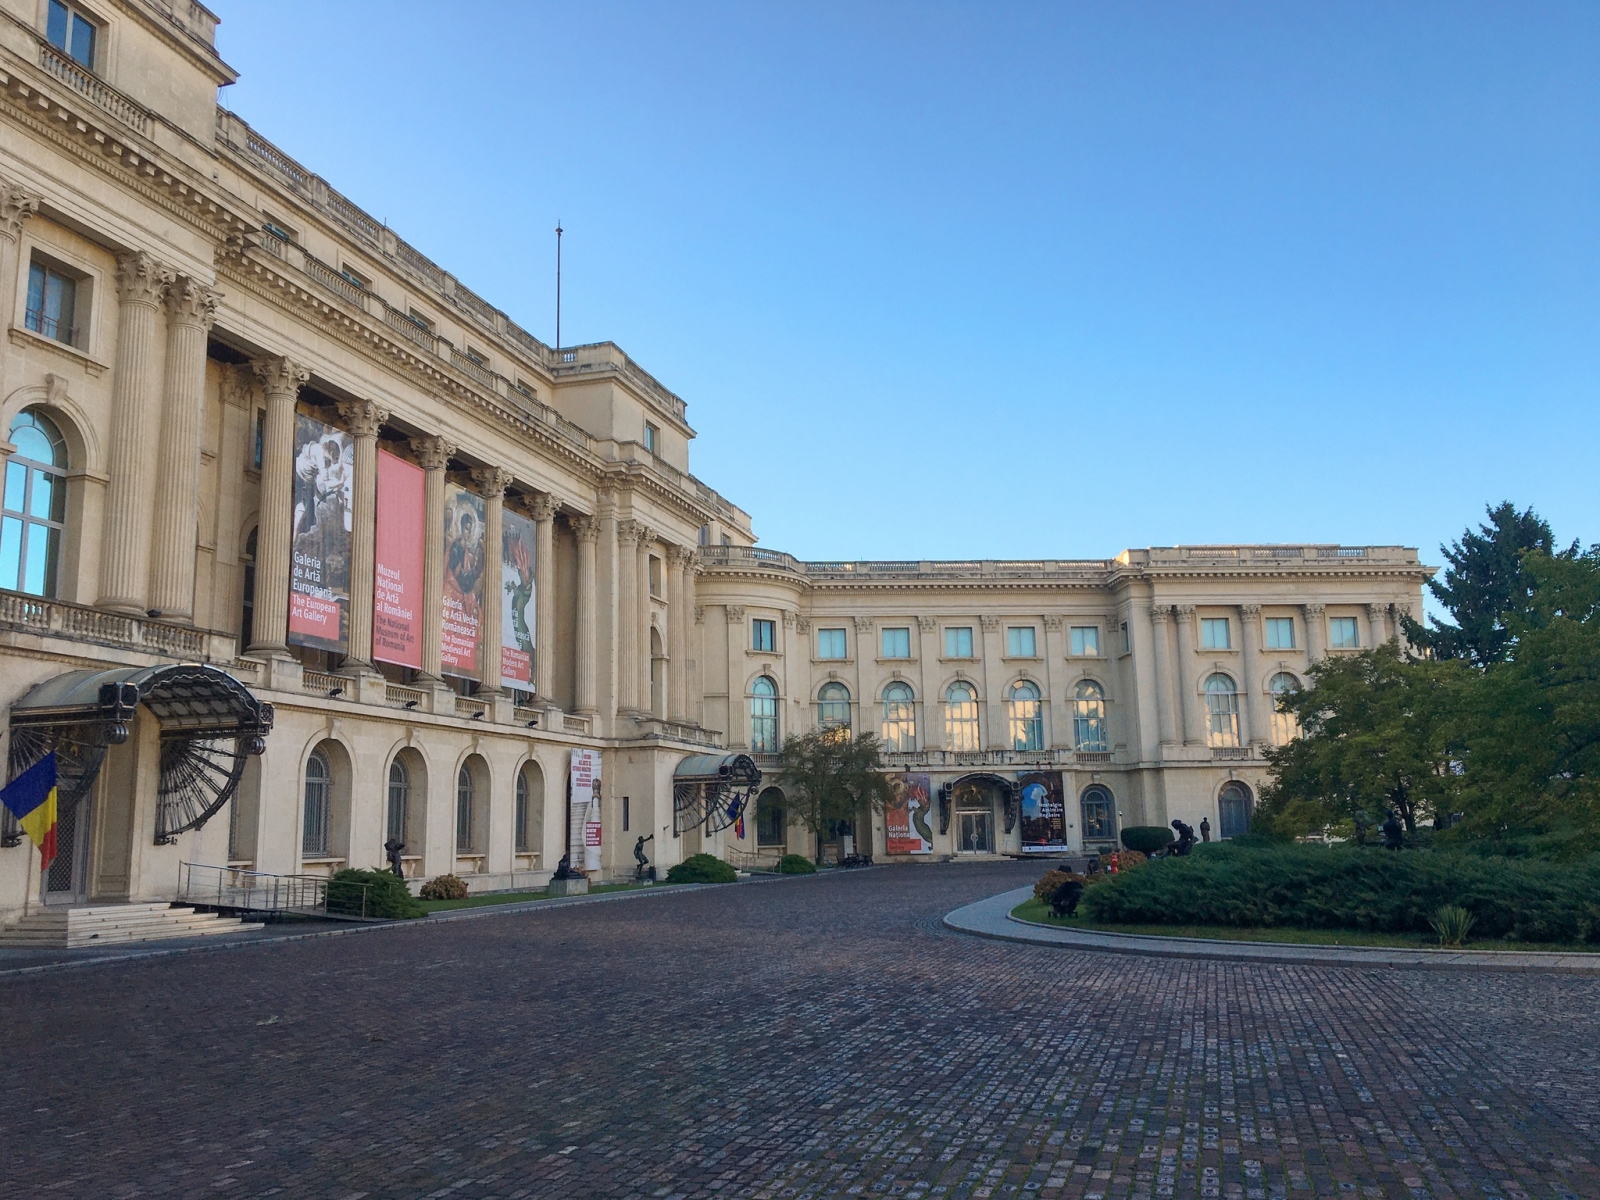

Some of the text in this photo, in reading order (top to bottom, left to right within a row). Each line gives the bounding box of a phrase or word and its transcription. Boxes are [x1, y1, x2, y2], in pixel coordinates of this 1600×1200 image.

[294, 551, 321, 569] Galeria
[293, 565, 320, 582] de Artă
[377, 563, 400, 580] Muzeul
[293, 578, 332, 598] Europeană
[376, 588, 399, 604] de Artă
[293, 594, 336, 613] The European
[376, 601, 412, 620] al României
[442, 595, 462, 610] Galeria
[292, 606, 327, 625] Art Gallery
[376, 614, 409, 632] The National
[442, 607, 478, 627] de Artă Veche
[376, 625, 414, 643] Museum of Art
[442, 619, 475, 637] Românească
[375, 636, 405, 652] of Romania
[442, 632, 474, 648] The Romanian
[441, 642, 471, 657] Medieval Art
[502, 647, 510, 657] The
[441, 652, 458, 666] Gallery
